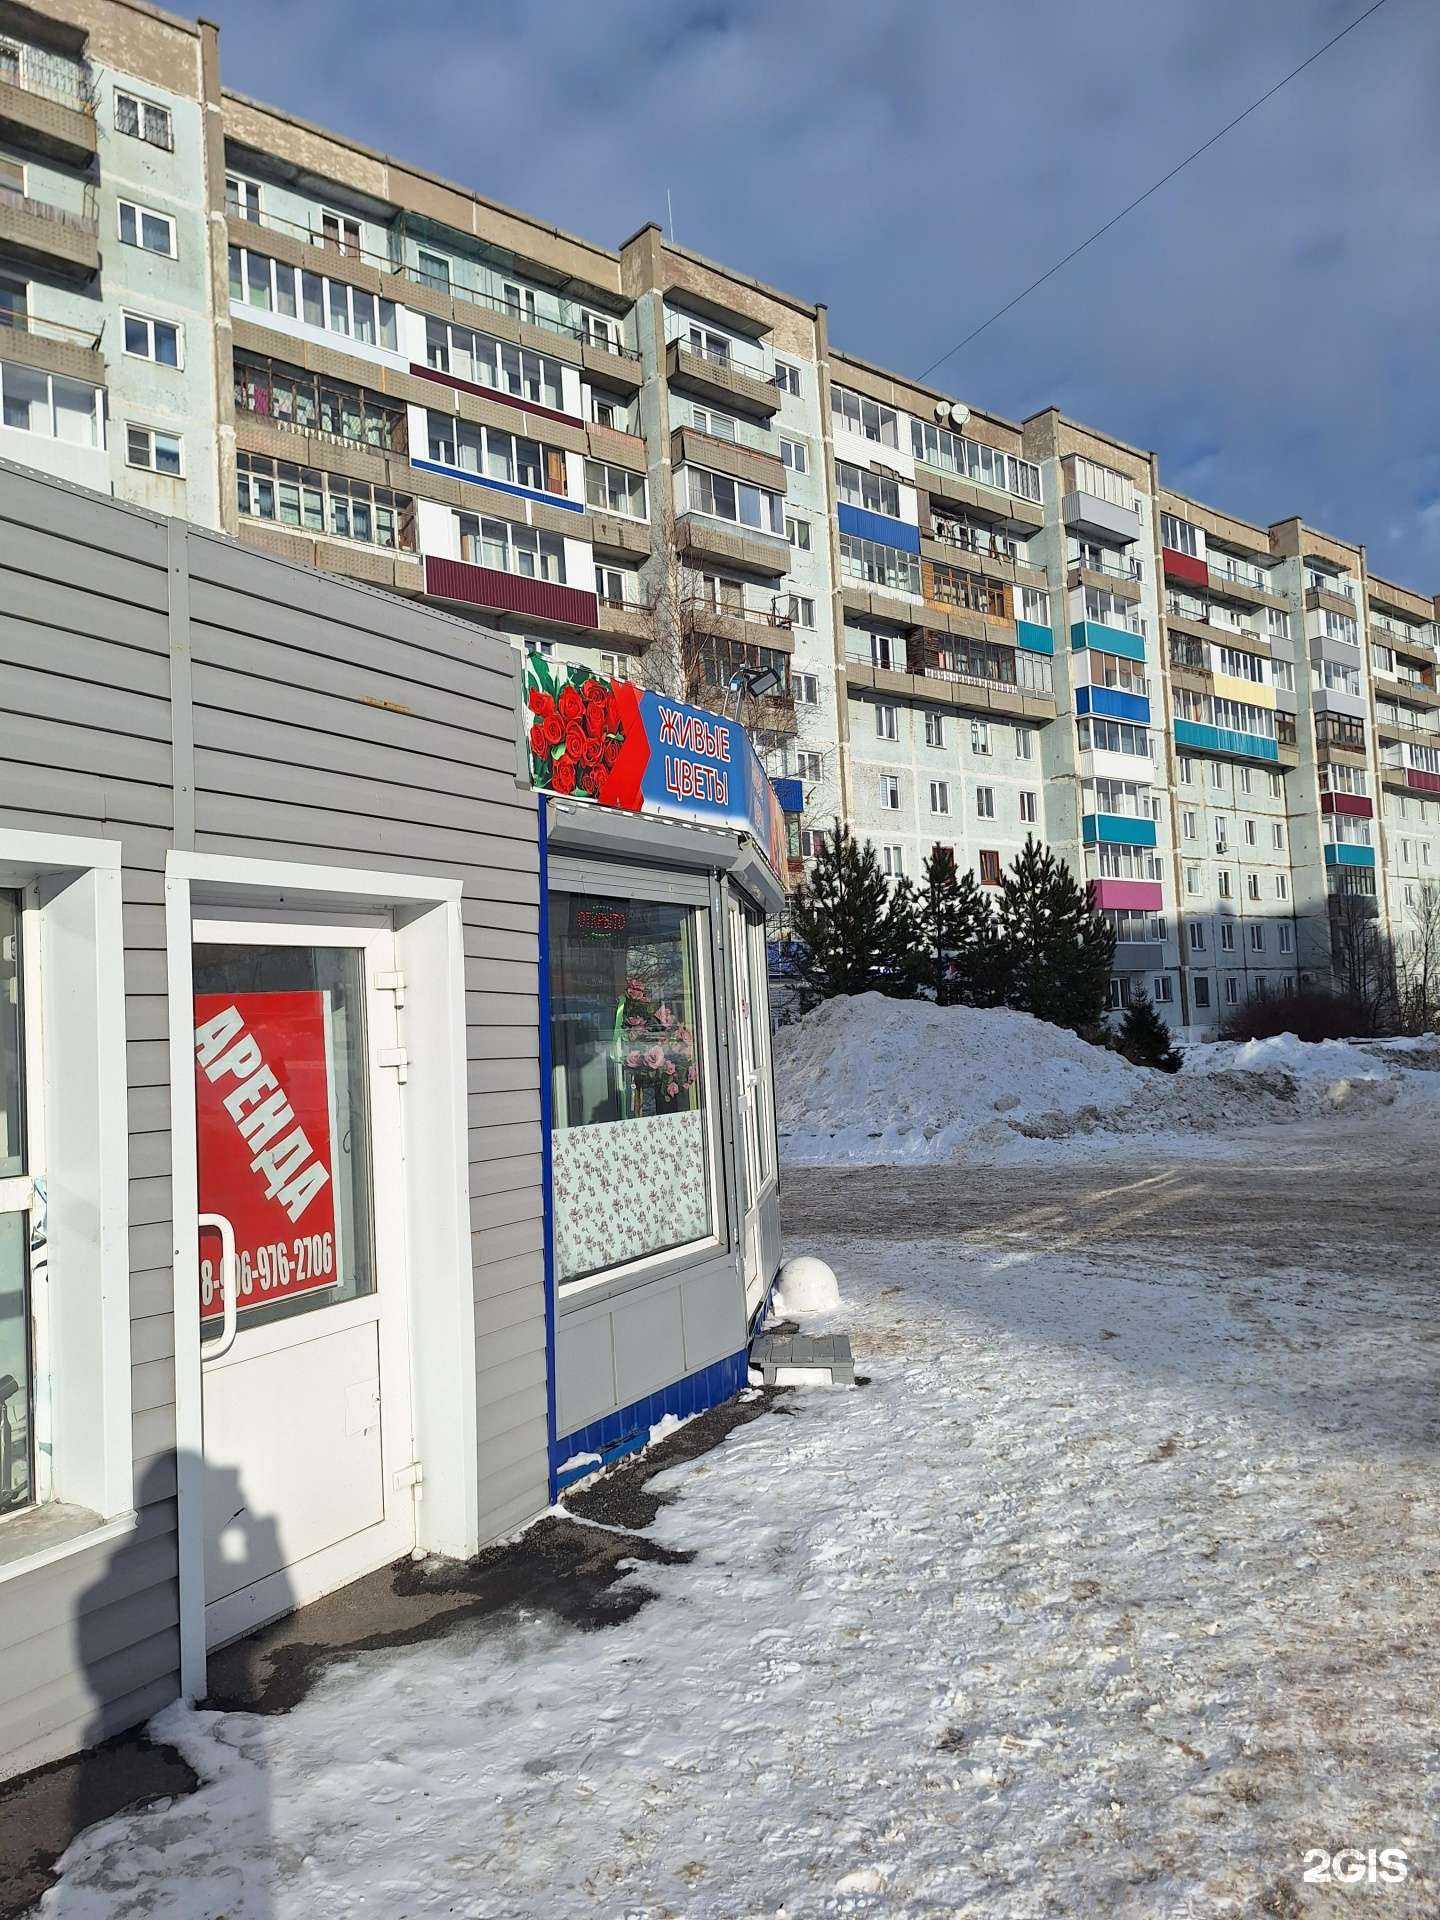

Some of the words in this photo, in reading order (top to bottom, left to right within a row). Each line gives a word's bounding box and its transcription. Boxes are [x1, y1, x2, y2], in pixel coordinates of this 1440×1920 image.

[658, 705, 730, 763] ЖИВЫЕ
[665, 756, 729, 805] ЦВЕТЫ
[195, 1005, 330, 1224] АРЕНДА
